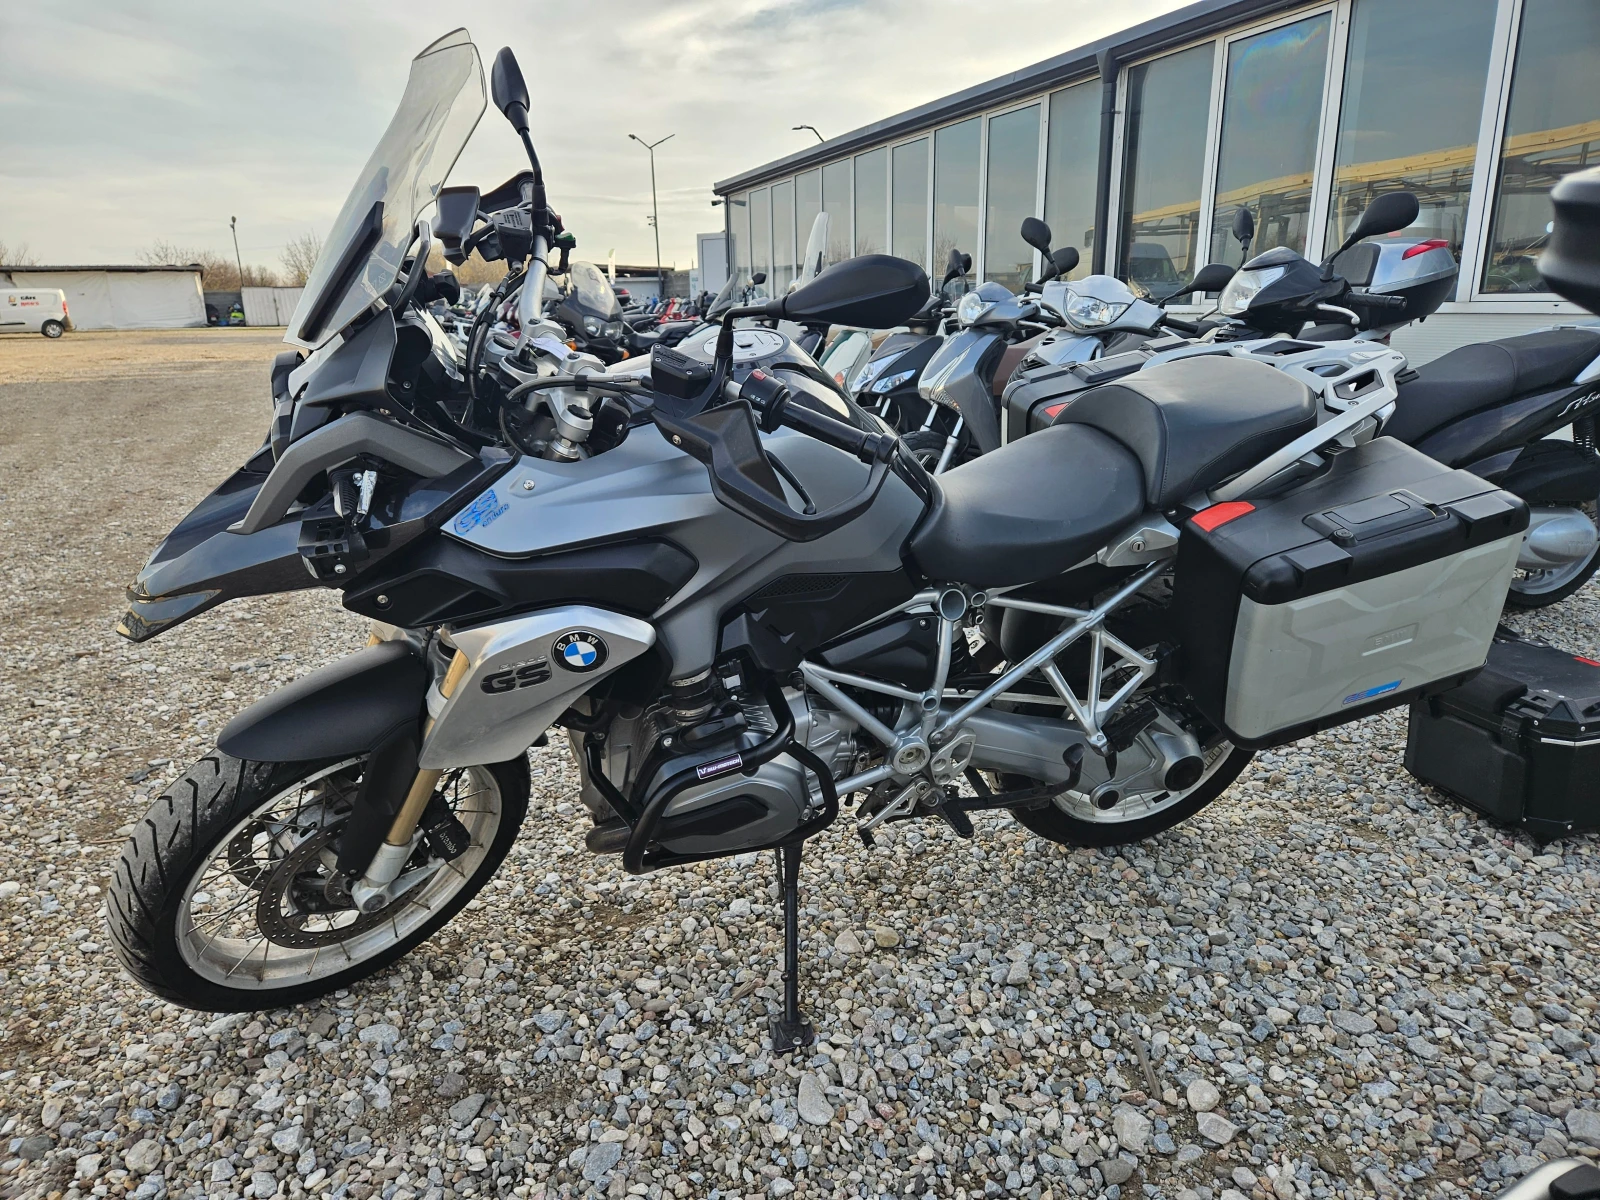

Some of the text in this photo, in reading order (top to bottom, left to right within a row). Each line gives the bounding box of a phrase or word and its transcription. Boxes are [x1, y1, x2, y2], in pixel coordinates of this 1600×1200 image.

[556, 633, 599, 652] BMW
[480, 660, 552, 696] GS
[440, 832, 457, 853] brembo
